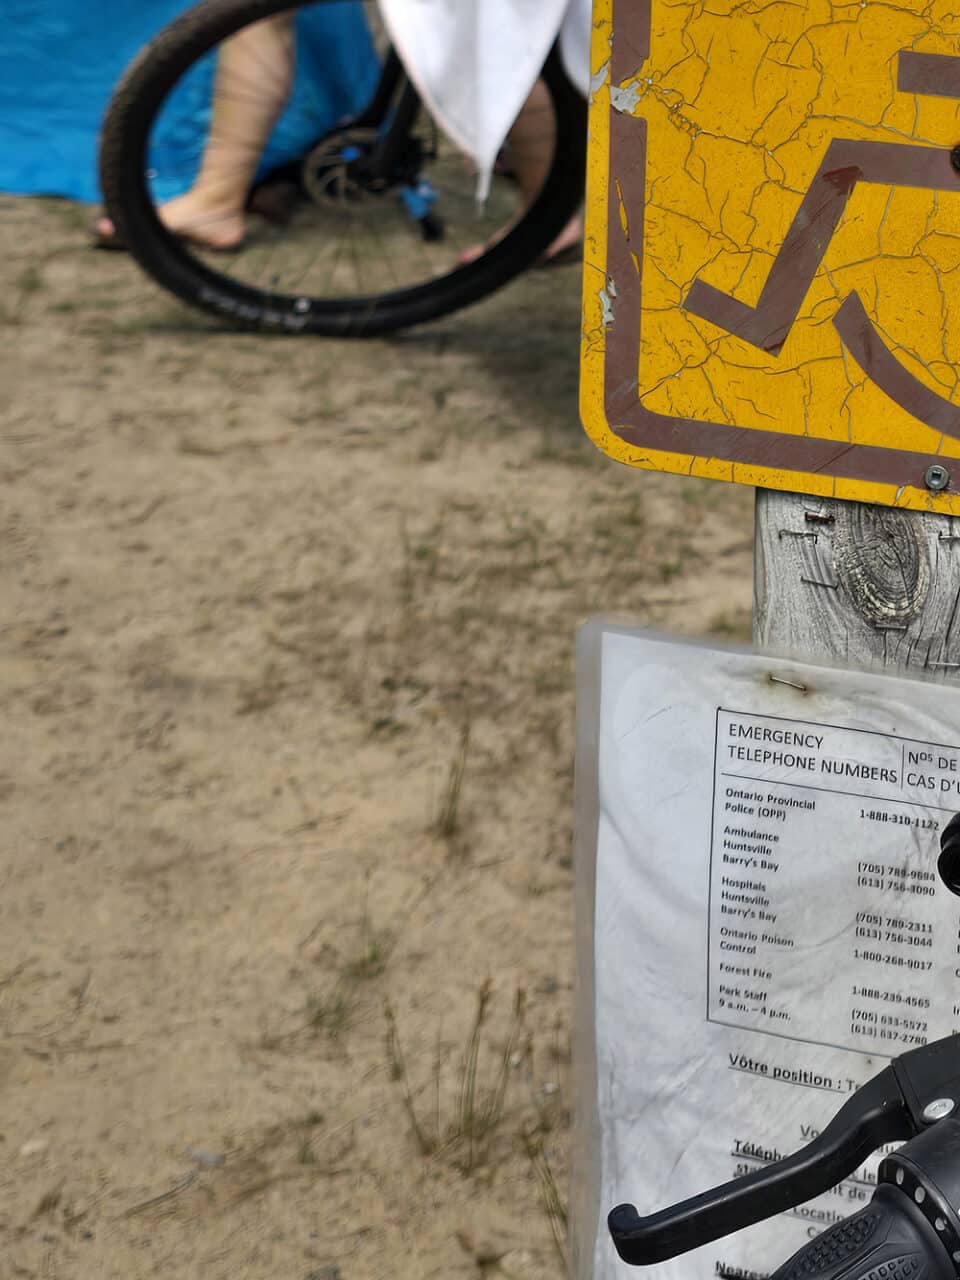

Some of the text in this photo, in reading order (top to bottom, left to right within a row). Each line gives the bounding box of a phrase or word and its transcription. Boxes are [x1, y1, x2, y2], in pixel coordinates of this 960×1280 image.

[728, 723, 824, 750] EMERGENCY
[727, 744, 898, 784] TELEPHONE NUMBERS
[938, 757, 957, 772] DE
[906, 772, 936, 790] CAS
[725, 787, 816, 811] Ontario Provincial
[724, 801, 786, 822] Police (OPP)
[859, 808, 940, 832] 1-888-310-1122
[723, 824, 780, 843] Ambulance
[723, 839, 773, 857] Huntsville
[722, 853, 780, 873] Barry's Bay
[857, 861, 885, 877] (705)
[721, 876, 766, 892] Hospitals
[857, 875, 884, 891] (613)
[720, 889, 770, 907] Huntsville
[758, 910, 777, 924] Bay
[855, 911, 932, 934] (705) 789-2311
[720, 926, 794, 948] Ontario Poison
[855, 925, 882, 942] (613)
[720, 940, 757, 955] Control
[719, 962, 750, 977] Forest
[719, 984, 768, 1002] Park Staff
[851, 1008, 878, 1025] (705)
[850, 1023, 878, 1039] (613)
[728, 1051, 769, 1074] Vôtre
[772, 1066, 833, 1088] position
